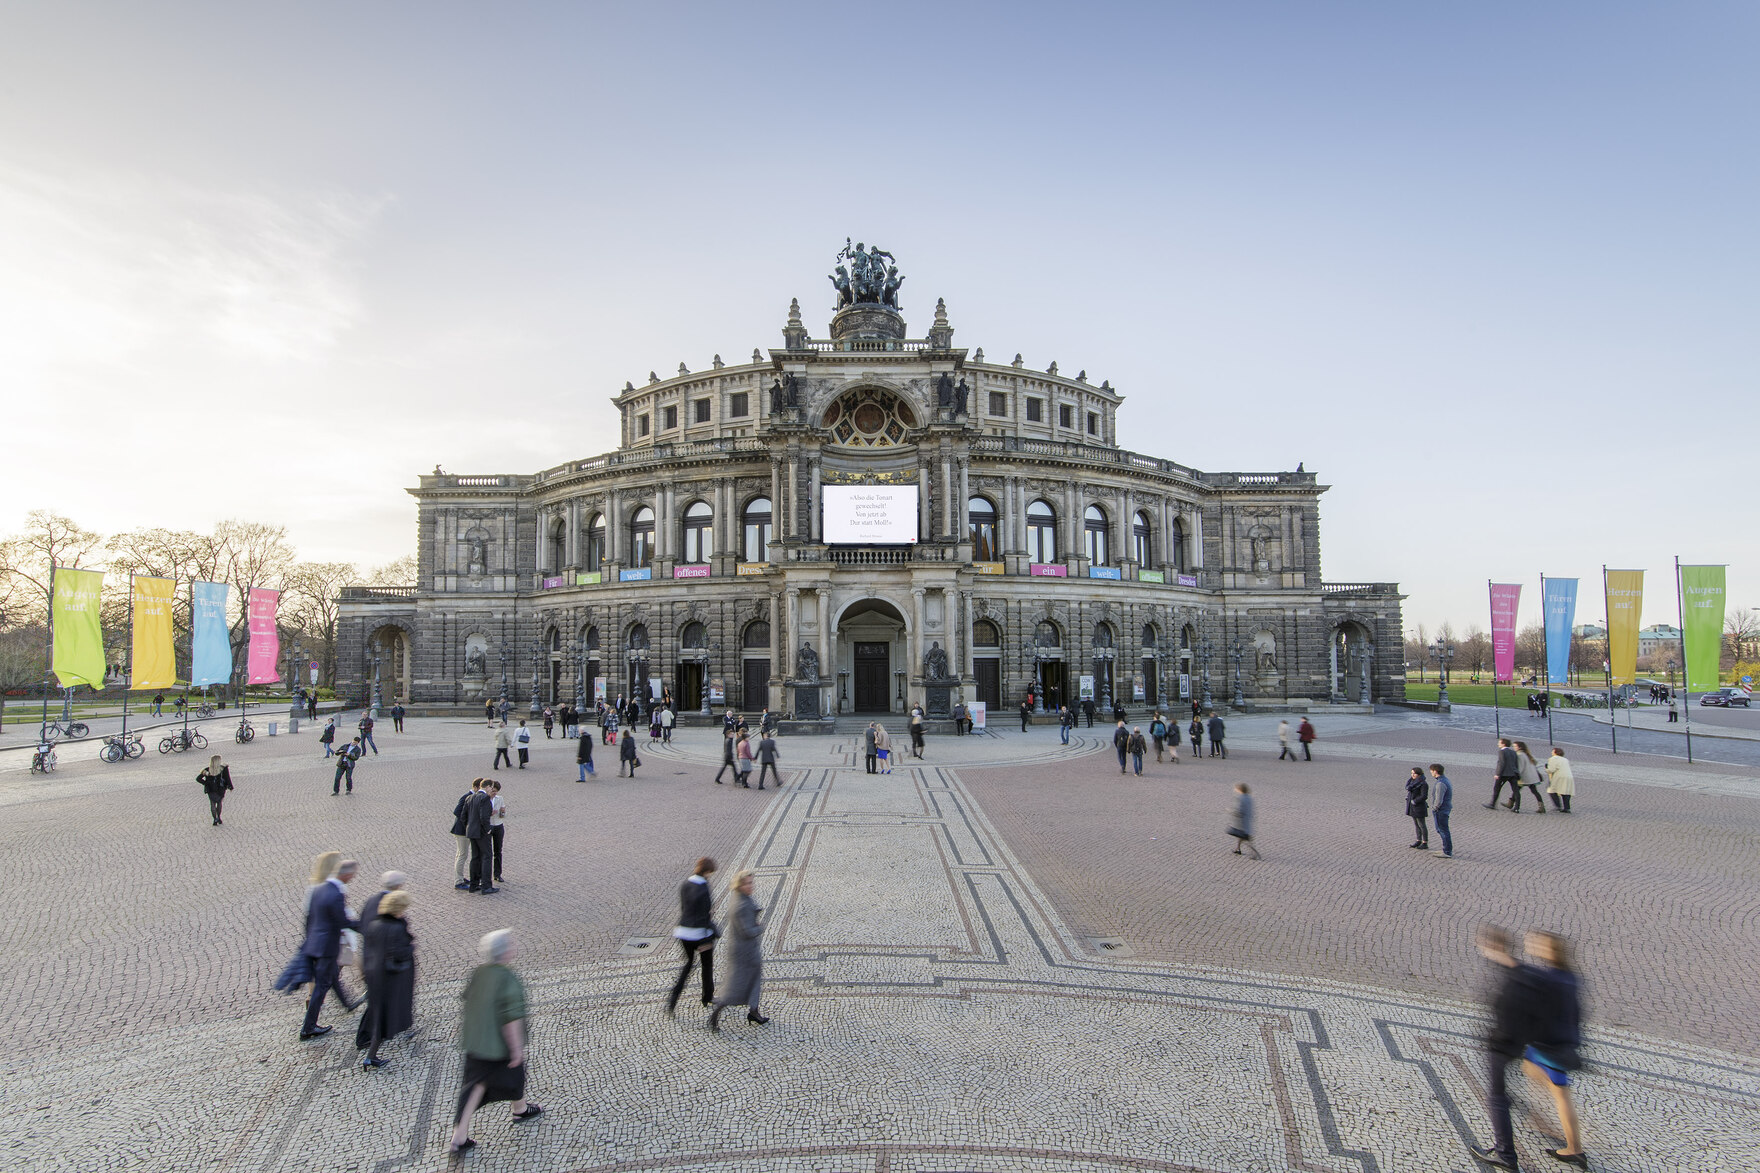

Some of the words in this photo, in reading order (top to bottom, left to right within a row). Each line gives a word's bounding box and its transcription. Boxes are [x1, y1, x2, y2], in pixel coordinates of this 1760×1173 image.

[626, 571, 644, 580] welt-
[677, 568, 707, 577] offenes
[1042, 567, 1055, 575] ein
[1097, 570, 1114, 578] welt-
[1178, 576, 1196, 586] Dresden
[57, 588, 96, 600] Augen
[1608, 588, 1641, 597] Herzen
[1686, 585, 1722, 597] Augen
[136, 594, 172, 604] Herzen
[198, 598, 222, 607] Türen
[64, 603, 87, 612] auf.
[145, 607, 164, 615] auf.
